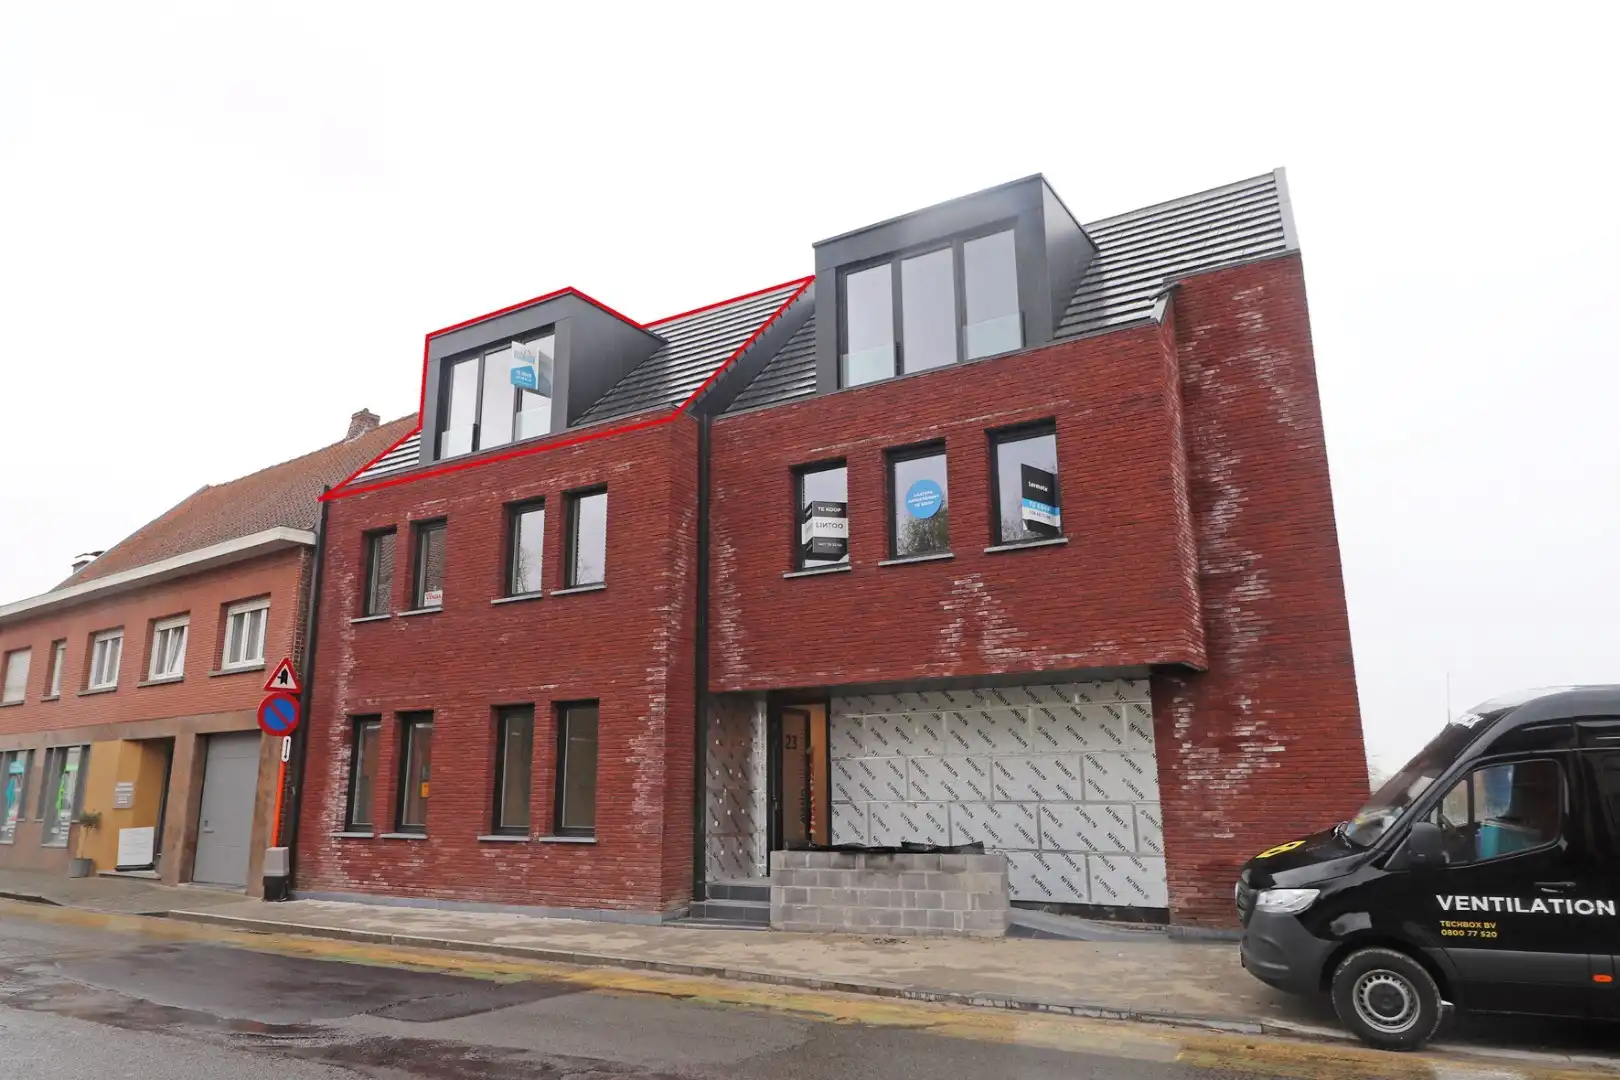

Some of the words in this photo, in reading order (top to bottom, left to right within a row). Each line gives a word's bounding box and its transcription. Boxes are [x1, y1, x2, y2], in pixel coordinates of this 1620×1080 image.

[785, 735, 797, 750] 23
[1124, 757, 1143, 774] UNILIN
[1126, 780, 1145, 799] UNILIN
[1099, 878, 1118, 898] UNILIN
[1126, 876, 1145, 896] UNILIN
[1436, 894, 1616, 916] VENTILATION
[1440, 920, 1482, 929] TECHBOX
[1484, 922, 1497, 930] BV
[1441, 929, 1465, 937] 0800
